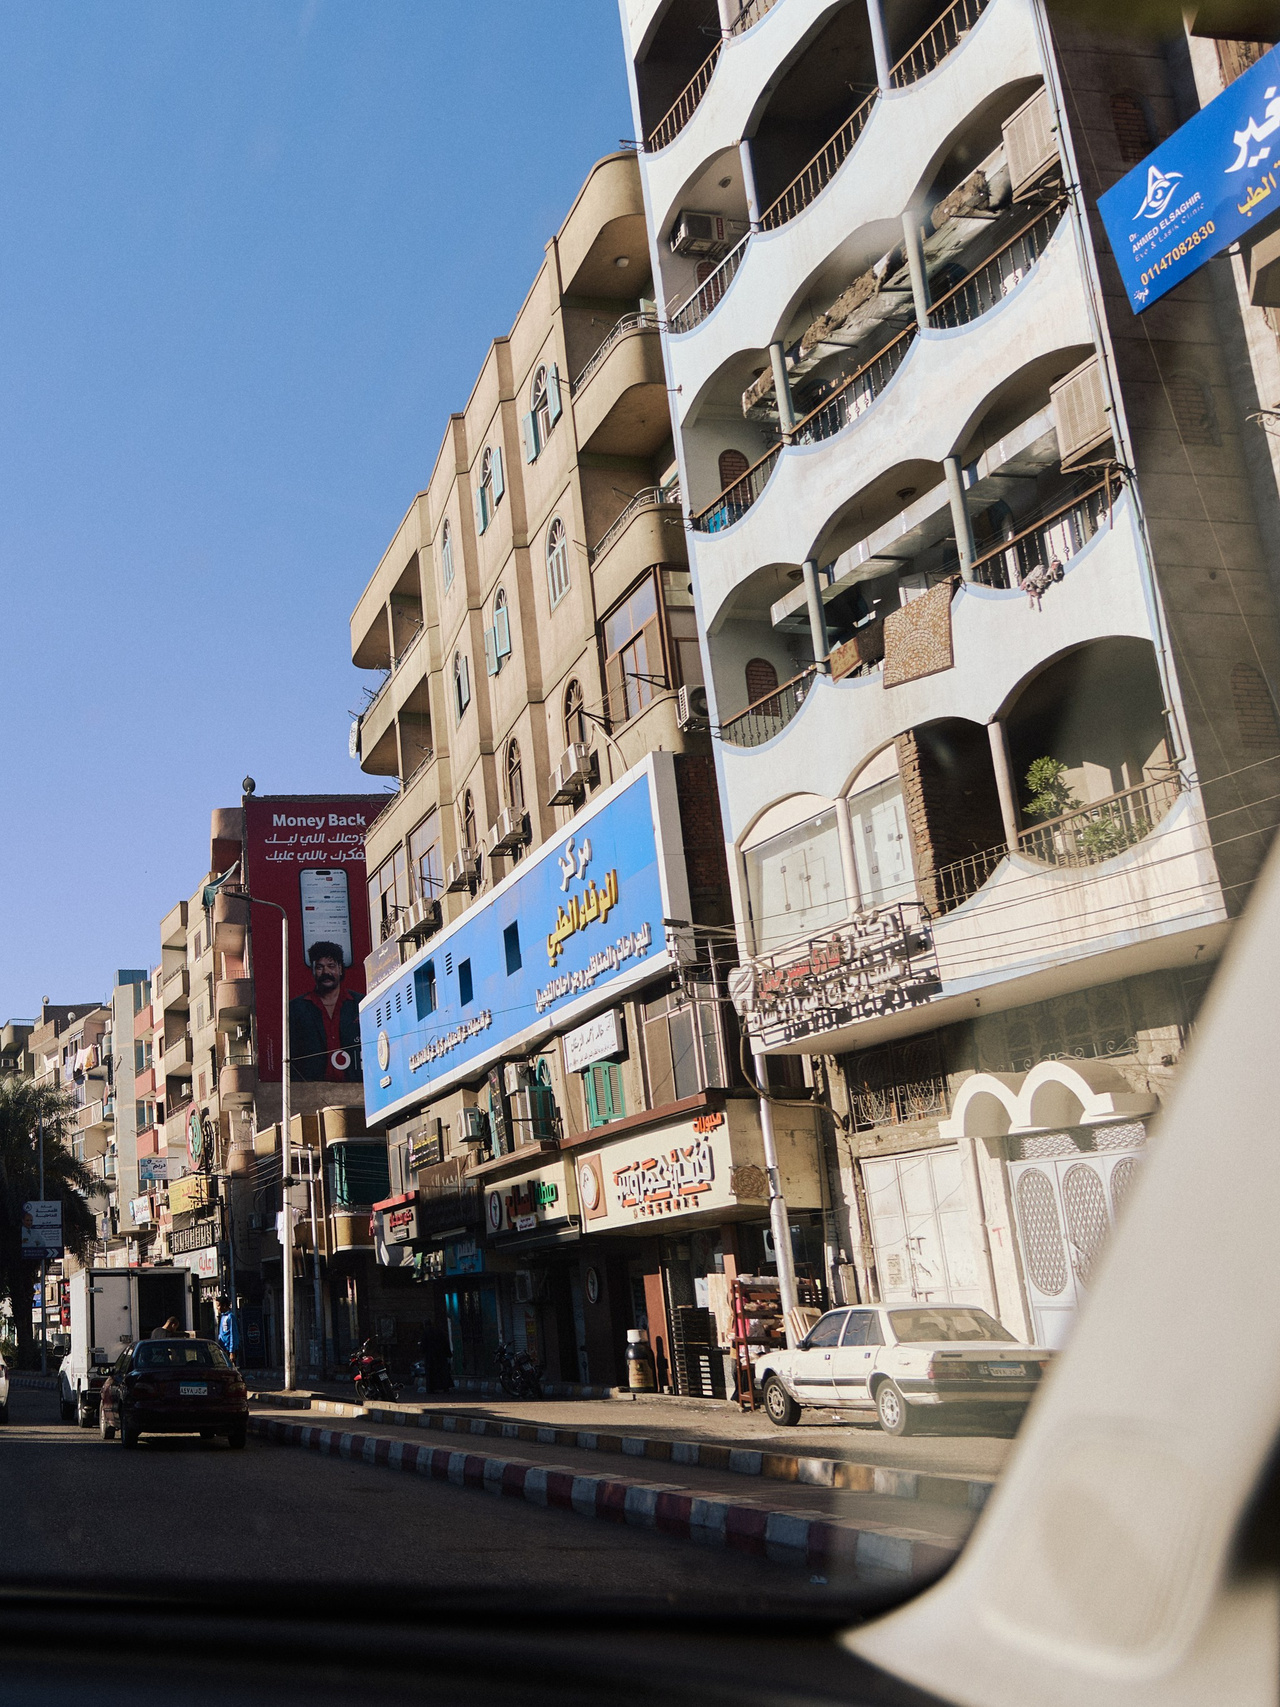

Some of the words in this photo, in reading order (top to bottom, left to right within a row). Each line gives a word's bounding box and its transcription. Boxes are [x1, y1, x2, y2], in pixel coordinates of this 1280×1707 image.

[1132, 226, 1160, 253] AHMED
[1159, 191, 1202, 230] ELSAGHIR
[1140, 220, 1216, 286] 01147082830
[272, 813, 325, 830] Money
[328, 813, 367, 827] Back
[265, 850, 295, 863] عليك
[558, 837, 593, 893] مركز
[579, 868, 619, 932] الوفاء
[546, 895, 580, 968] الطبي
